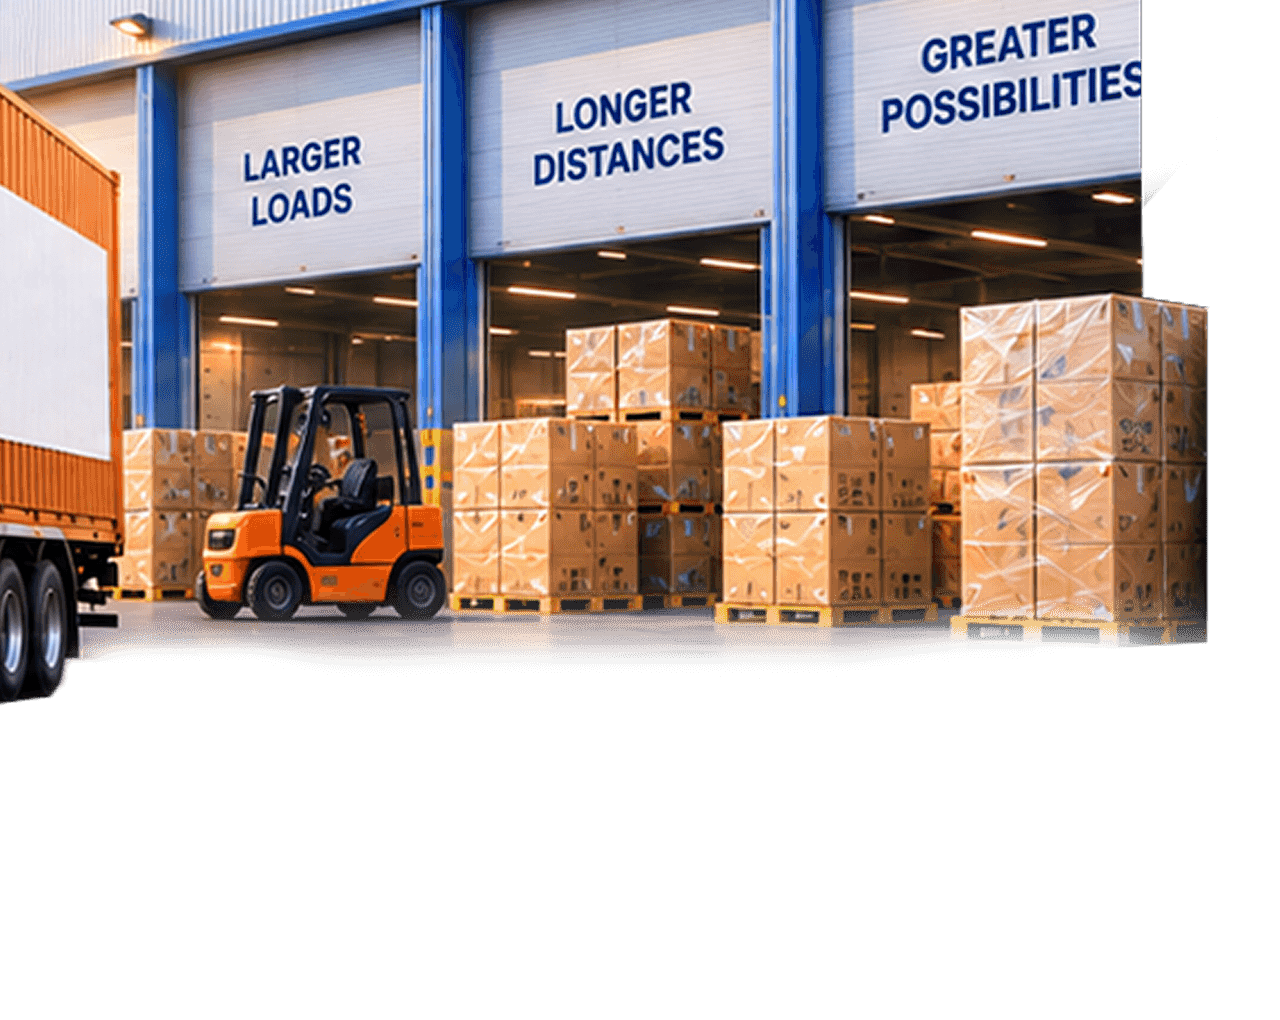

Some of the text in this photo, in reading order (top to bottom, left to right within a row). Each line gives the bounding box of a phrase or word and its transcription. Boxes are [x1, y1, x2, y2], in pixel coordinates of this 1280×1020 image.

[920, 12, 1098, 75] GREATER
[555, 80, 693, 135] LONGER
[881, 59, 1142, 135] POSSIBILITIES
[243, 134, 362, 183] LARGER
[533, 125, 726, 187] DISTANCES
[251, 182, 354, 228] LOADS
